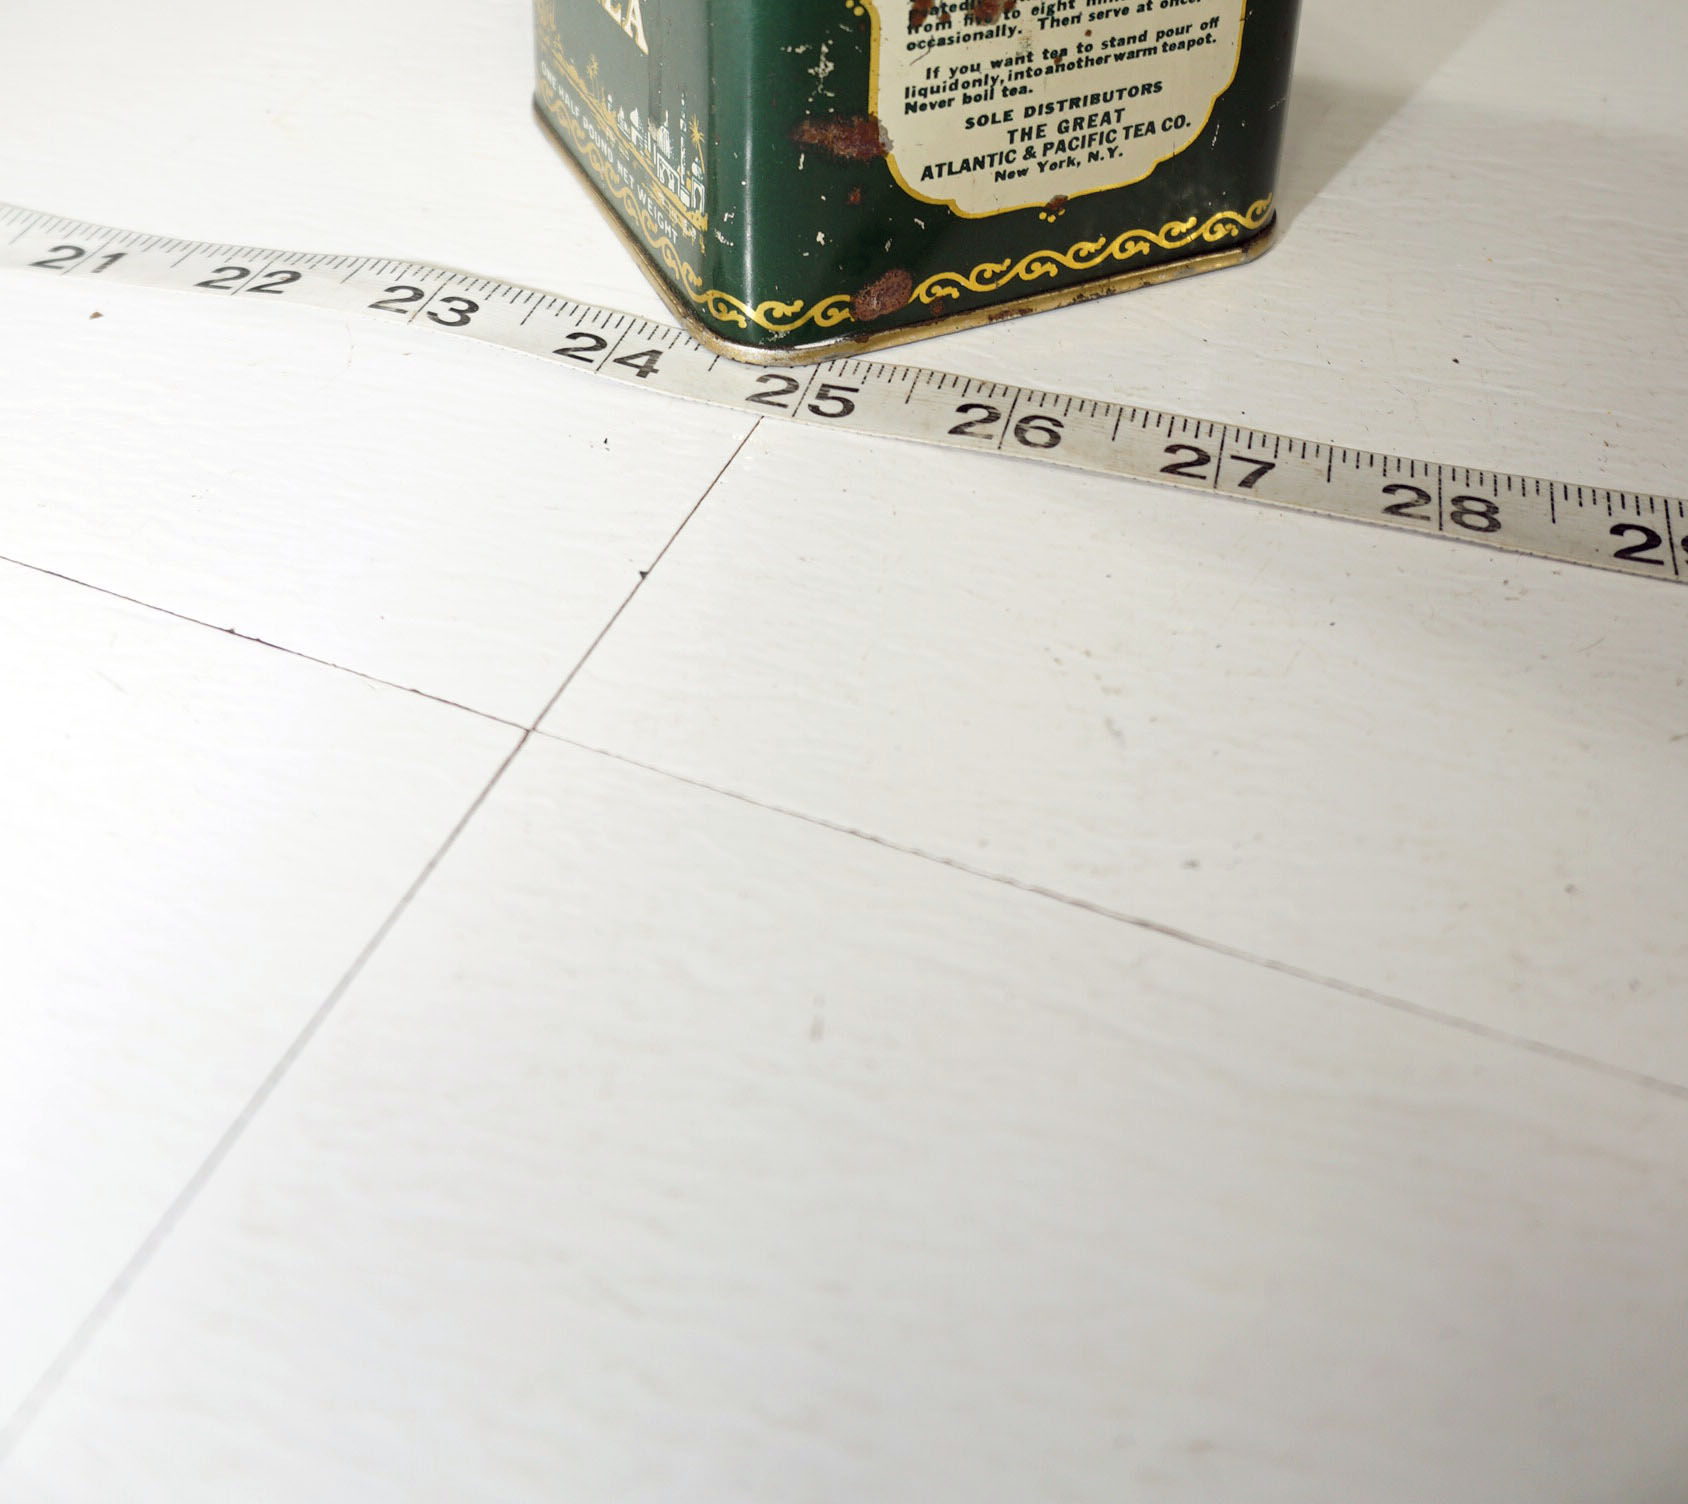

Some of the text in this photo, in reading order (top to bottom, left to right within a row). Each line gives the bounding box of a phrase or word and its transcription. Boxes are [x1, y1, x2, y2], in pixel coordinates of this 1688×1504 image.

[906, 24, 1022, 51] occasionally.
[1037, 14, 1082, 31] Then
[1088, 6, 1129, 22] serve
[1136, 2, 1155, 13] at
[907, 20, 951, 35] from
[1003, 8, 1021, 21] to
[926, 17, 1219, 80] If you want tea to stand pour off
[1162, 38, 1217, 54] teapot.
[904, 84, 1033, 115] Never boil tea.
[965, 81, 1163, 129] SOLE DISTRIBUTORS
[920, 115, 1191, 181] ATLANTIC & PACIFIC TEA CO.
[1008, 108, 1125, 144] THE GREAT
[583, 116, 613, 163] POUND
[617, 159, 634, 189] NET
[637, 185, 678, 244] WEIGHT
[994, 147, 1123, 183] New York, N.Y.
[28, 245, 128, 273] 21
[194, 267, 302, 295] 22
[368, 285, 480, 327] 23
[552, 332, 664, 378] 24
[746, 374, 859, 418] 25
[948, 403, 1064, 449] 26
[1159, 444, 1276, 489] 27
[1382, 484, 1502, 533] 28
